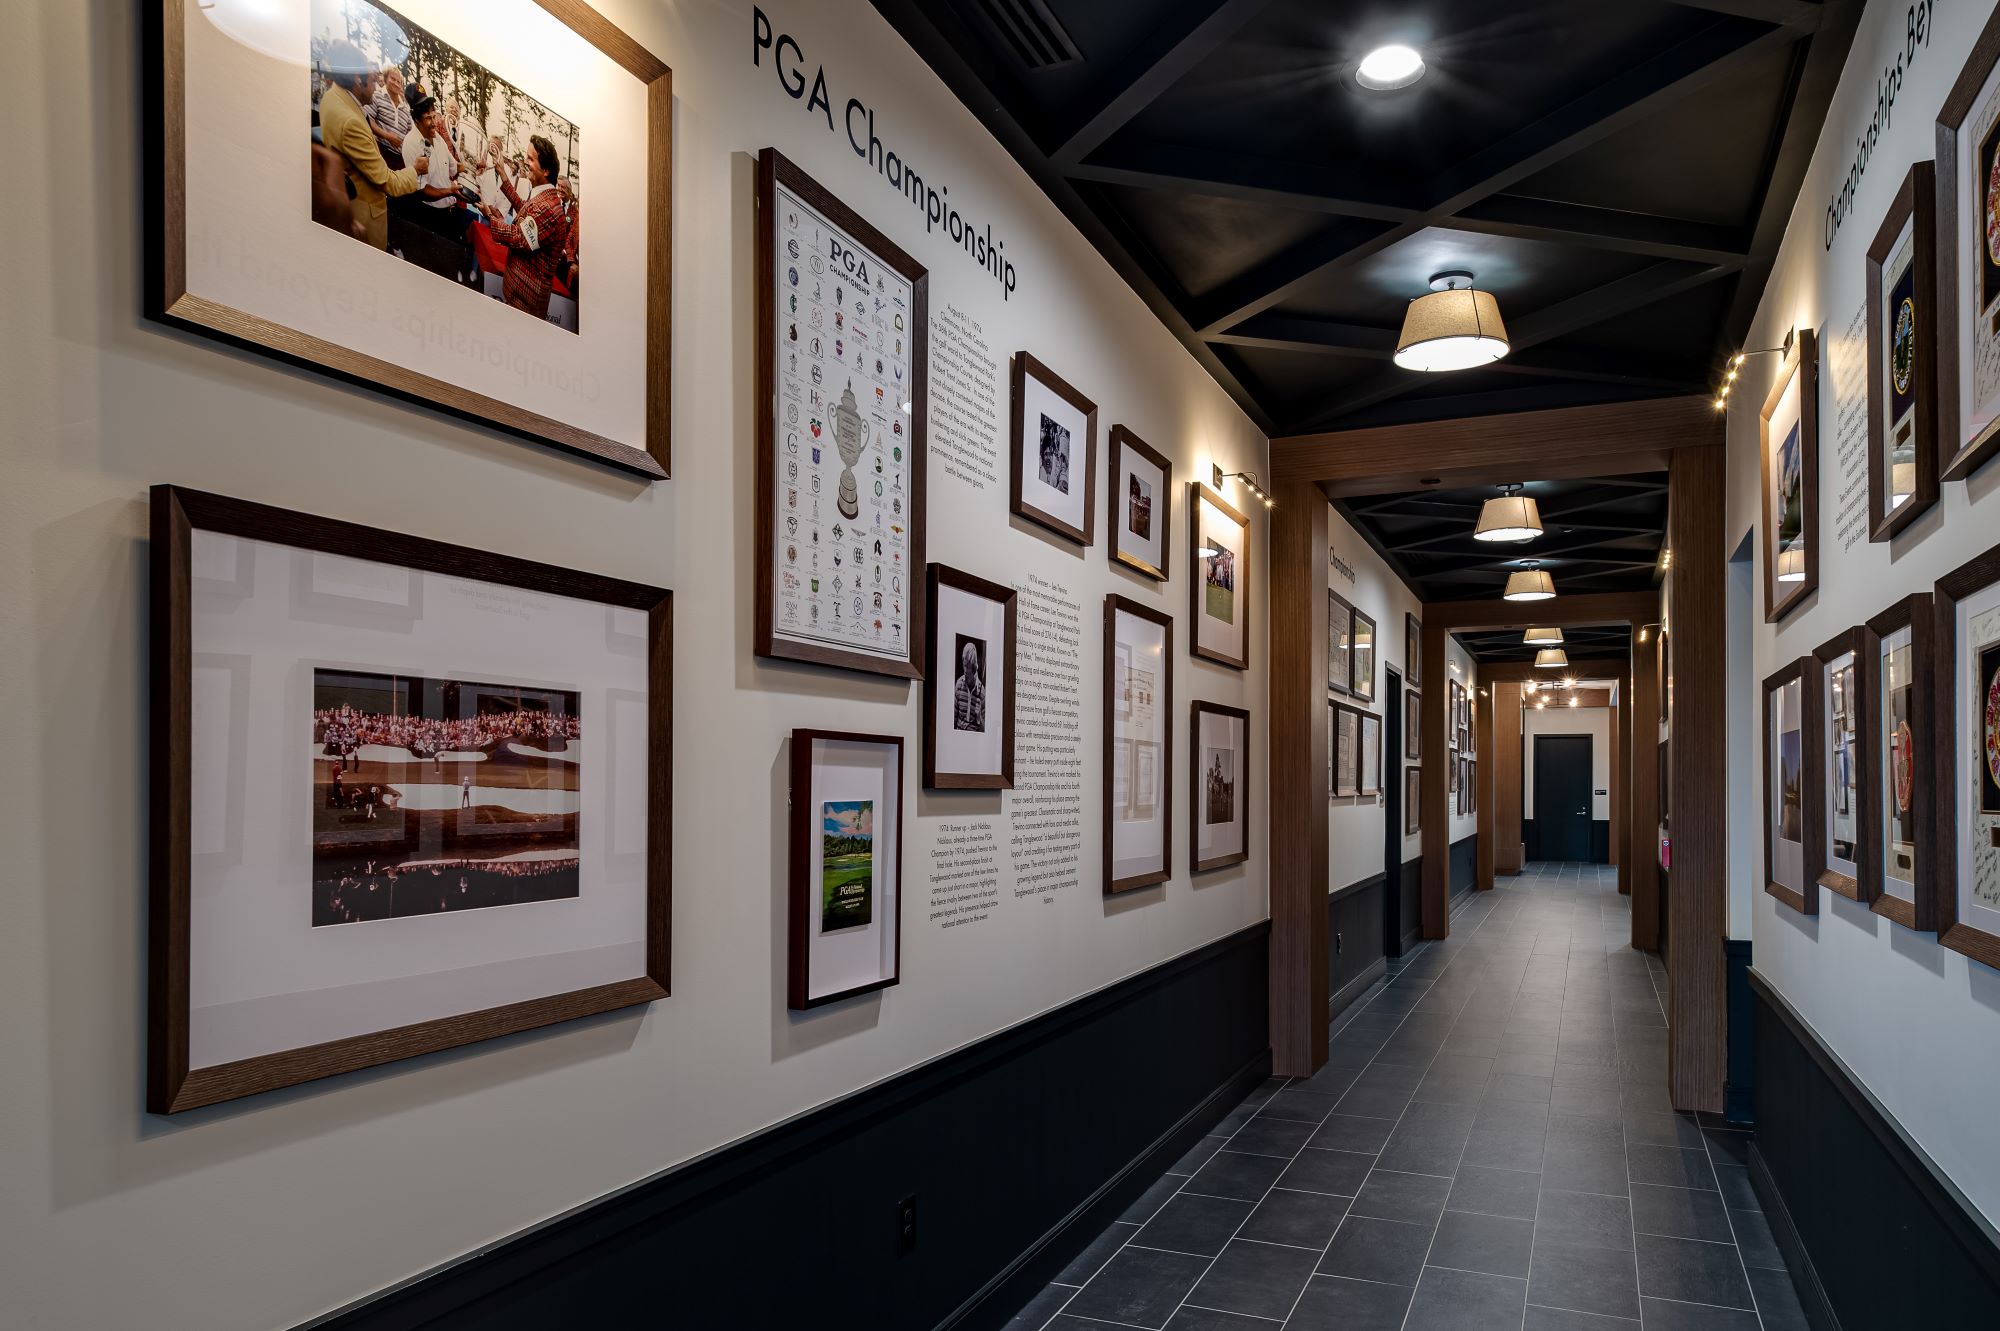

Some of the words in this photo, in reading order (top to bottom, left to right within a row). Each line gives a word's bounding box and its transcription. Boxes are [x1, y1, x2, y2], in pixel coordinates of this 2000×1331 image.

[753, 4, 835, 132] PGA
[845, 98, 1016, 300] Championship
[1825, 51, 1903, 252] Championships
[1906, 0, 1941, 70] Bey
[829, 237, 870, 286] PGA
[829, 264, 870, 297] CHAMPIONSHIP
